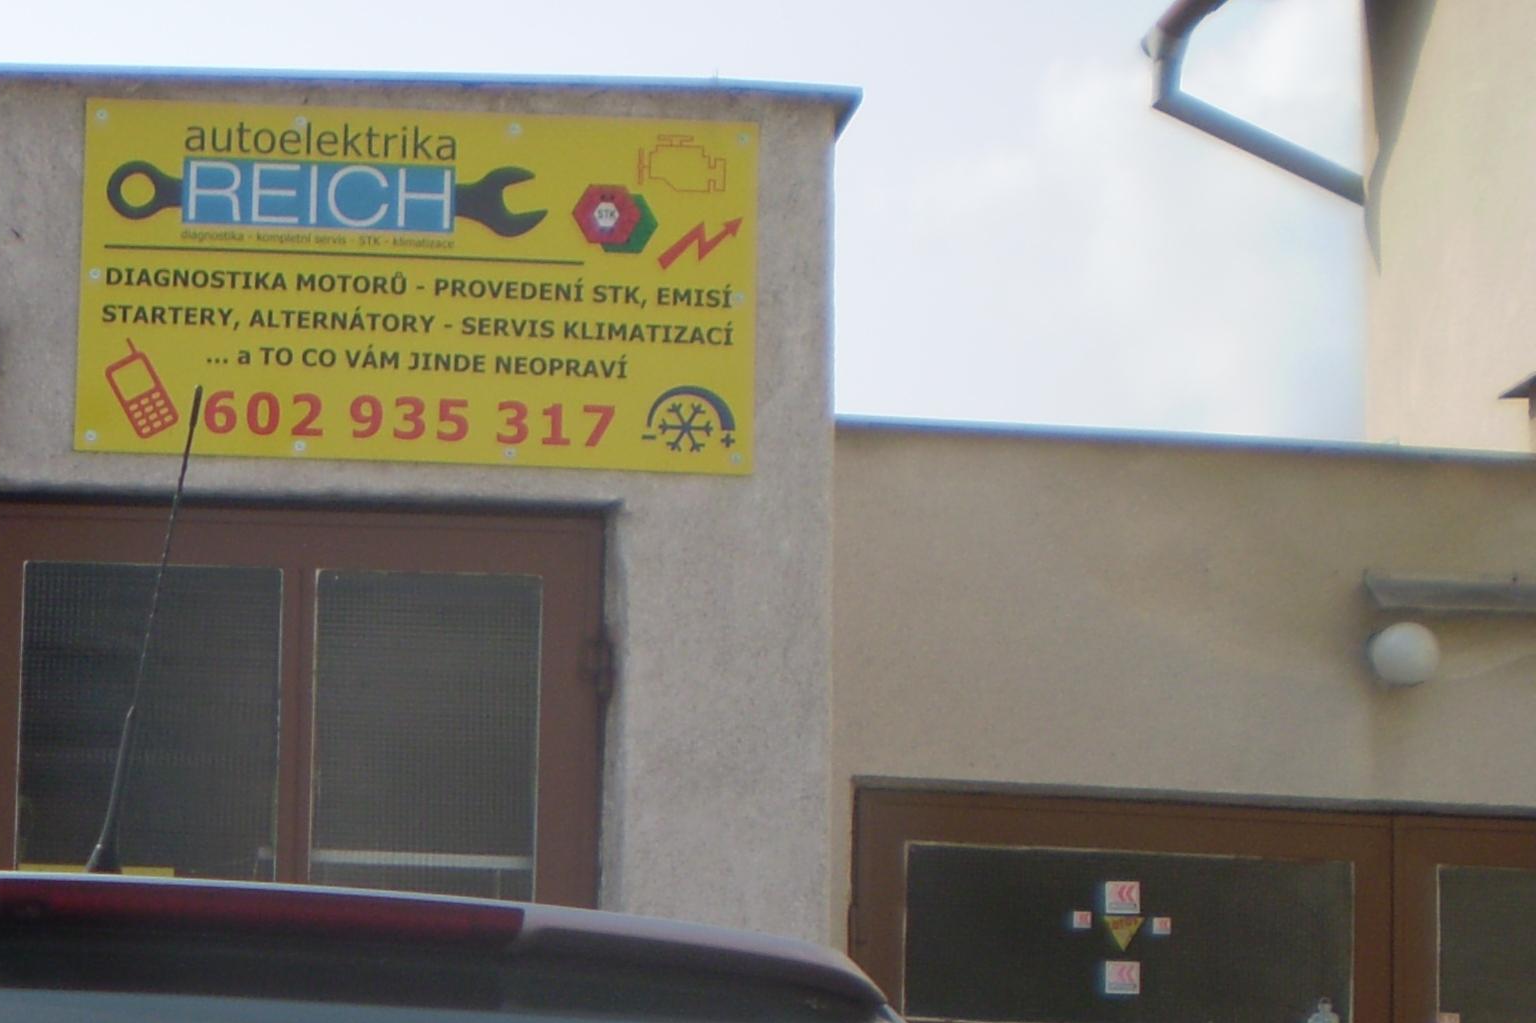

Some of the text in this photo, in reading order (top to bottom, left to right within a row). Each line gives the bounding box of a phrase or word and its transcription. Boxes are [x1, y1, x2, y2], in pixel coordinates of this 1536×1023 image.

[184, 121, 457, 161] autoelektrika
[187, 159, 452, 230] REICH
[180, 229, 244, 243] diagnostika
[256, 231, 311, 246] kompletní
[315, 233, 346, 245] servis
[359, 234, 380, 246] STK
[393, 235, 455, 249] klimatizace
[105, 267, 288, 291] DIAGNOSTIKA
[296, 271, 408, 295] MOTORŮ
[434, 278, 584, 303] PROVEDENÍ
[593, 284, 648, 309] STK,
[656, 284, 733, 308] EMISÍ
[101, 304, 241, 331] STARTERY,
[249, 306, 435, 333] ALTERNÁTORY
[461, 316, 556, 338] SERVIS
[564, 320, 735, 346] KLIMATIZACÍ
[238, 350, 251, 365] a
[260, 347, 293, 367] TO
[301, 348, 336, 368] CO
[345, 344, 400, 370] VÁM
[408, 351, 486, 373] JINDE
[495, 354, 628, 378] NEOPRAVÍ
[203, 390, 617, 448] 602 935 317
